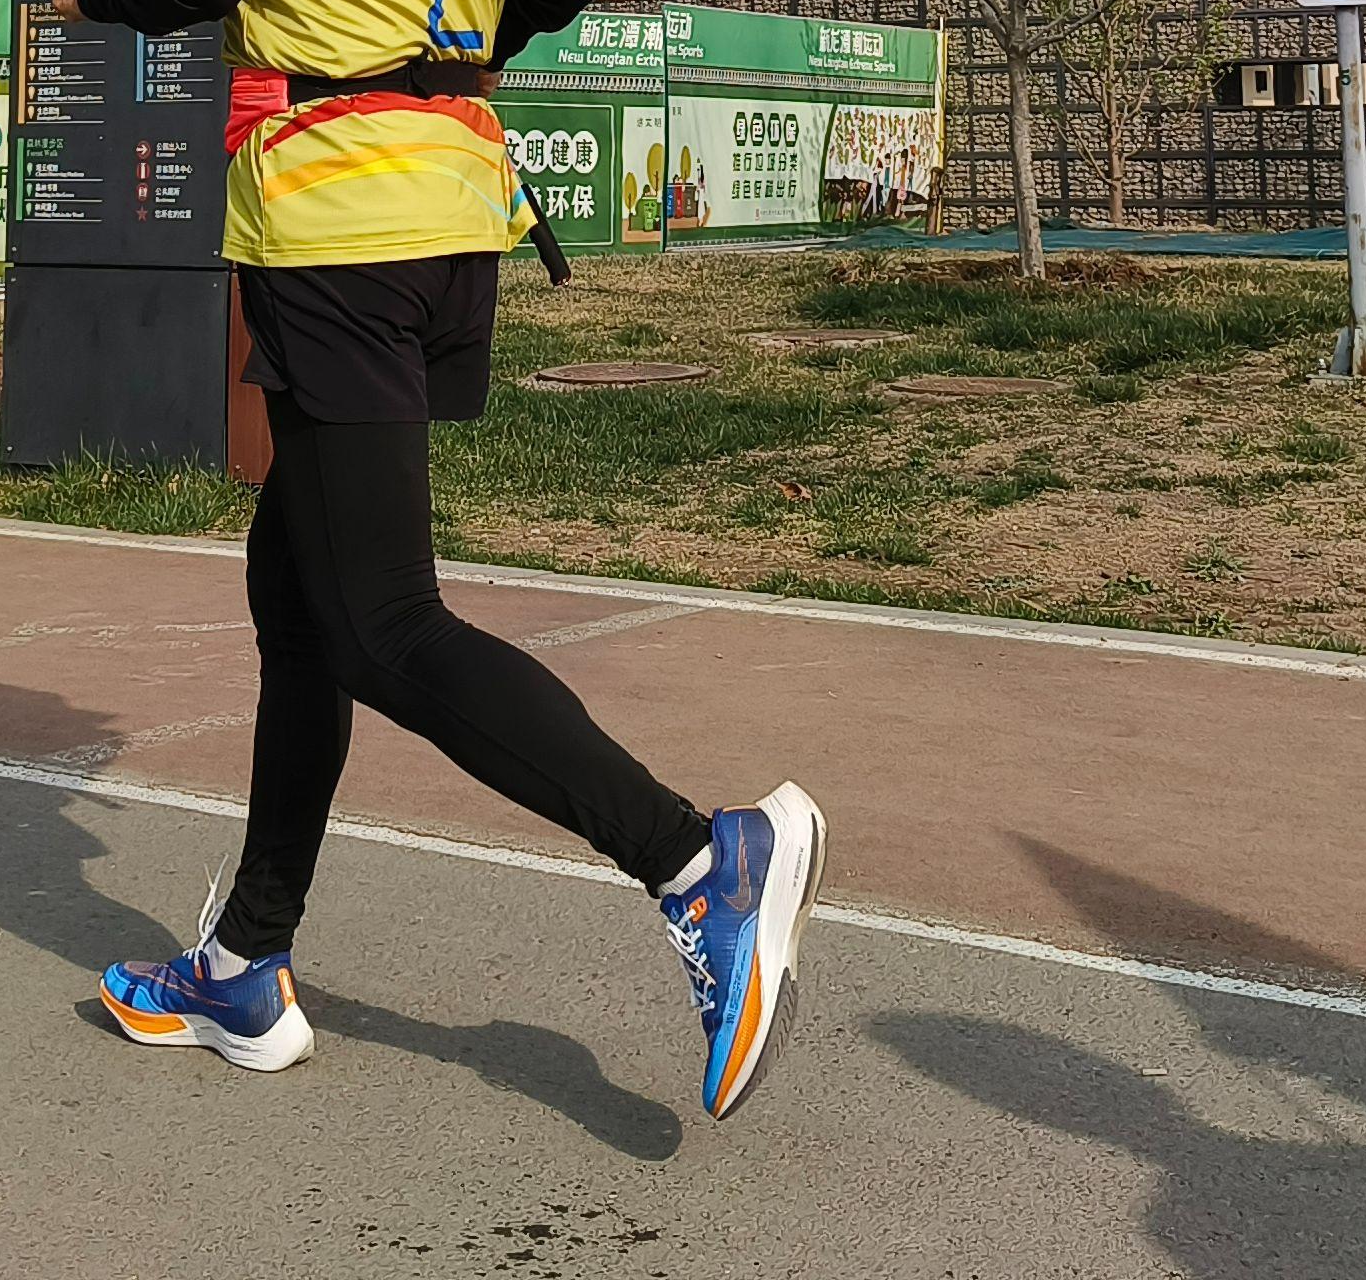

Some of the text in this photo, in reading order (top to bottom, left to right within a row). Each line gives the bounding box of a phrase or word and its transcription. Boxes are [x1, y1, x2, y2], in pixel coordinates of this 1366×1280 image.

[558, 49, 584, 64] New
[586, 51, 633, 68] Longtan
[506, 138, 594, 168] 文明健康
